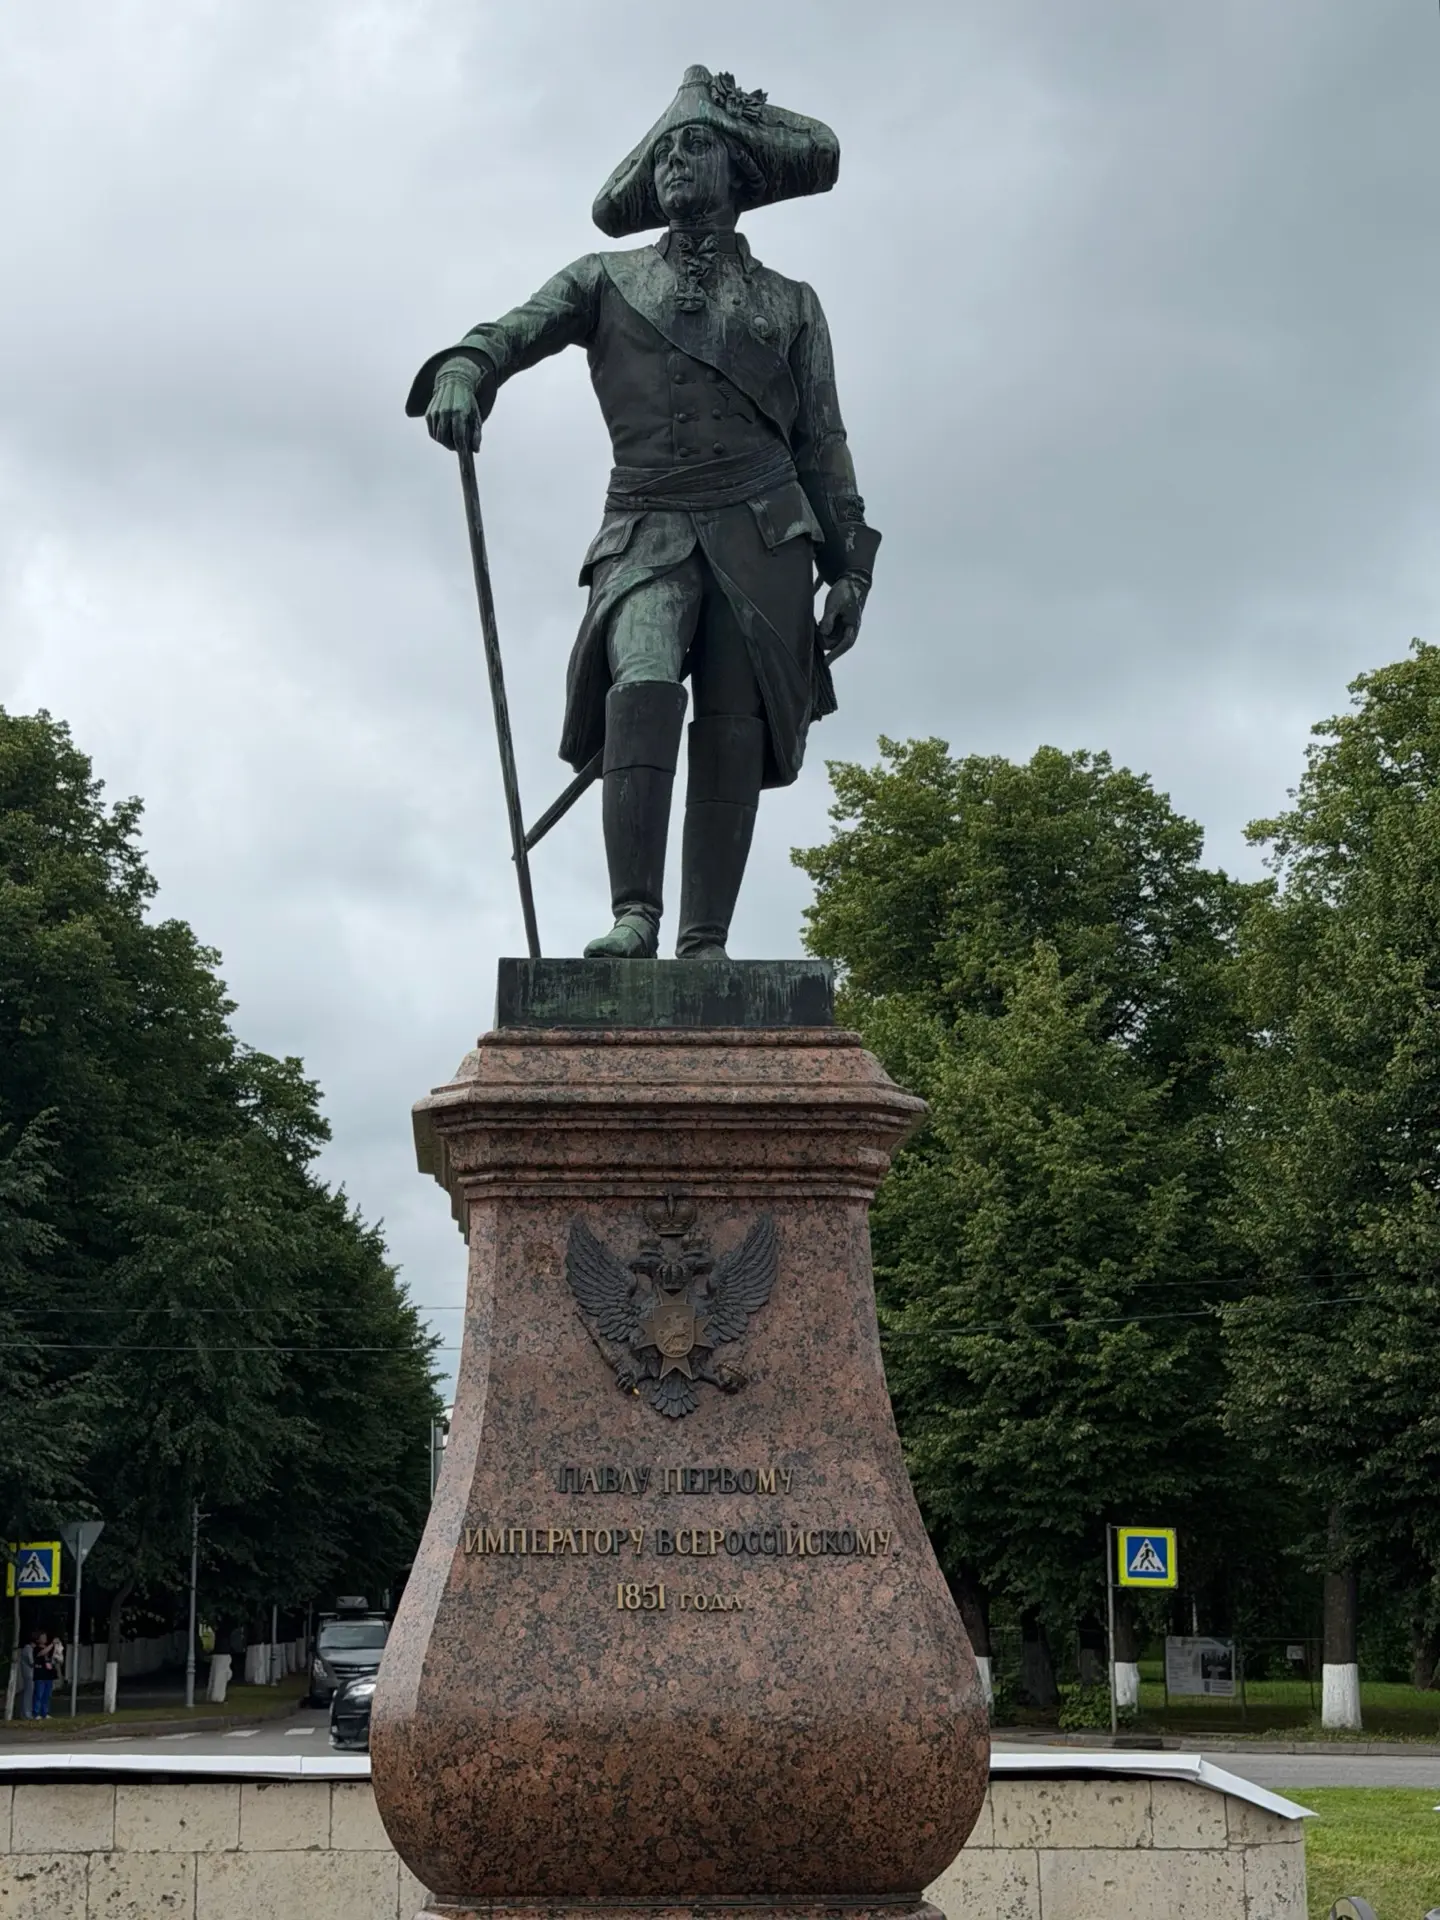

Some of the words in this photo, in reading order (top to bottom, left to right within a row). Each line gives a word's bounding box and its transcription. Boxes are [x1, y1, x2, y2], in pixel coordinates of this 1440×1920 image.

[558, 1467, 650, 1493] ПАВЛУ
[663, 1467, 794, 1494] ПЕРВОМУ
[464, 1526, 645, 1555] ИМПЕРАТОРУ
[617, 1583, 665, 1610] 1851
